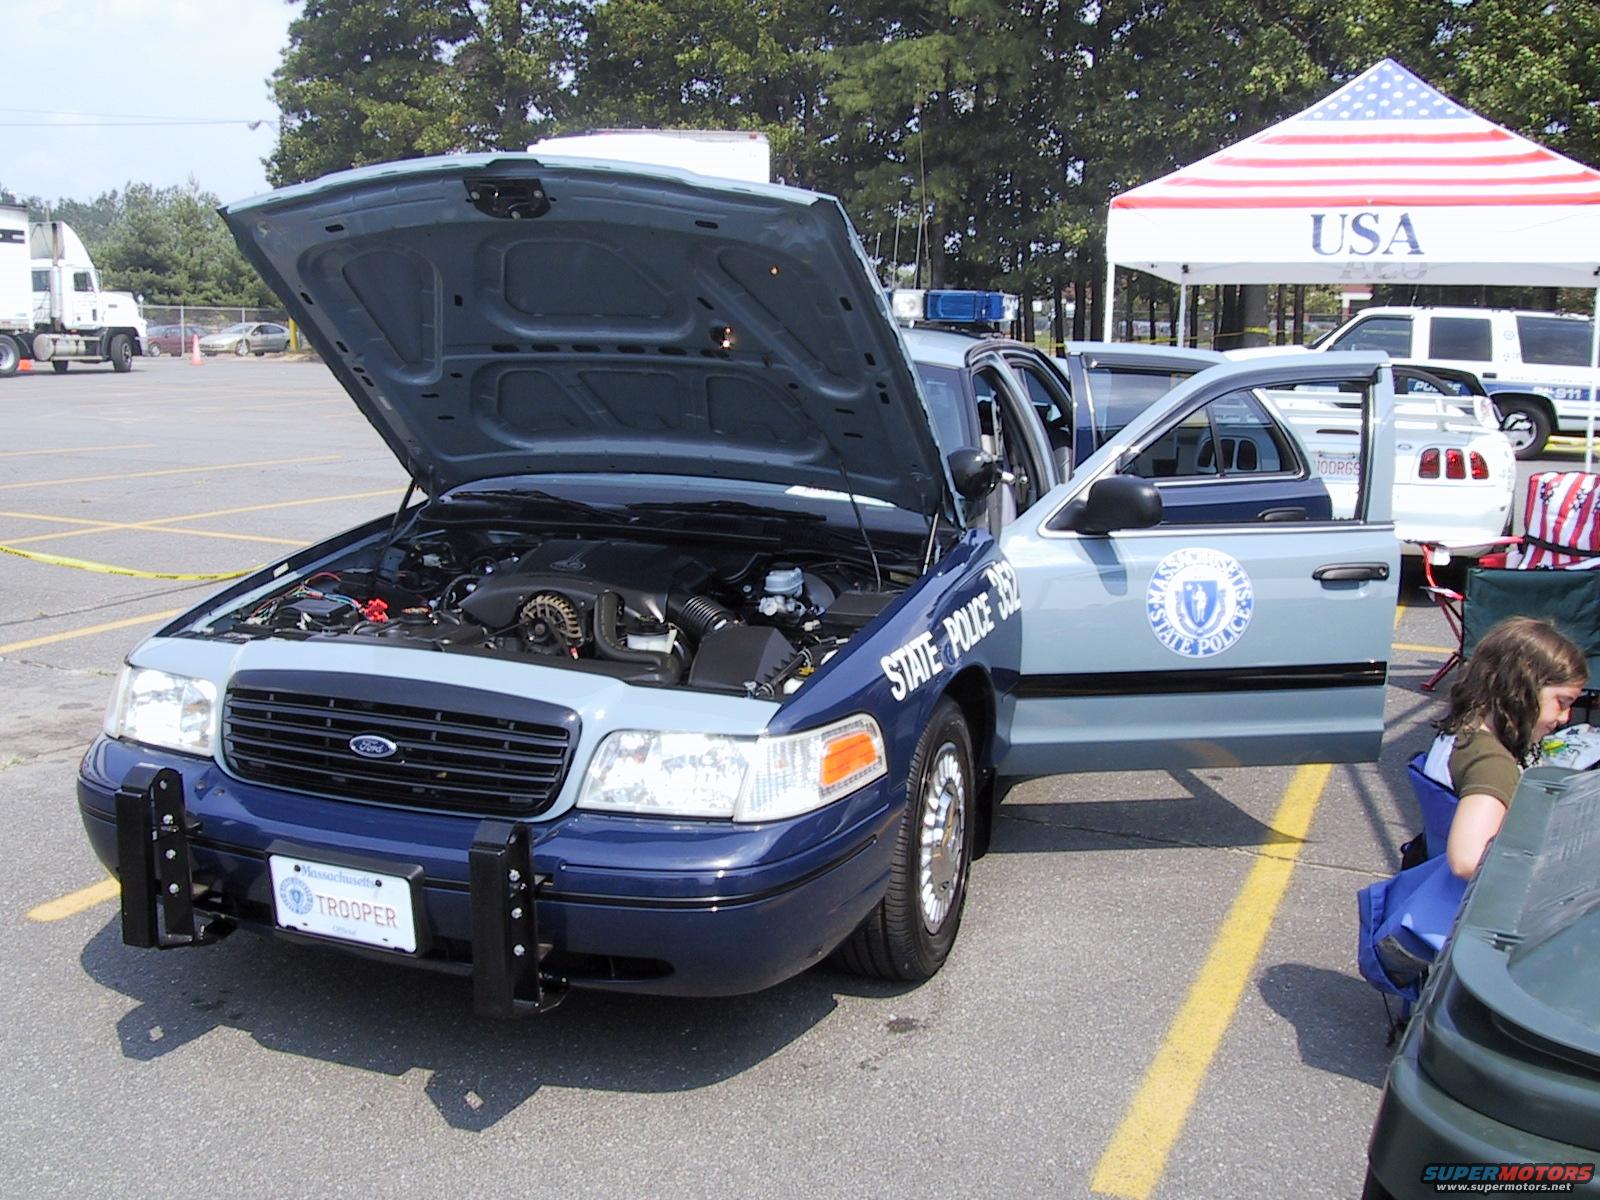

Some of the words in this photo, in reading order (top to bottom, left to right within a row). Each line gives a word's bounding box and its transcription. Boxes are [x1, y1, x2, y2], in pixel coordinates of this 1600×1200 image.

[1310, 212, 1425, 256] USA
[880, 630, 944, 701] STATE
[942, 591, 996, 659] POLICE
[985, 559, 1022, 621] 352
[1150, 608, 1193, 654] STATE
[1198, 605, 1250, 655] POLICE
[301, 864, 376, 889] Massachusetts
[315, 894, 398, 929] TROOPER
